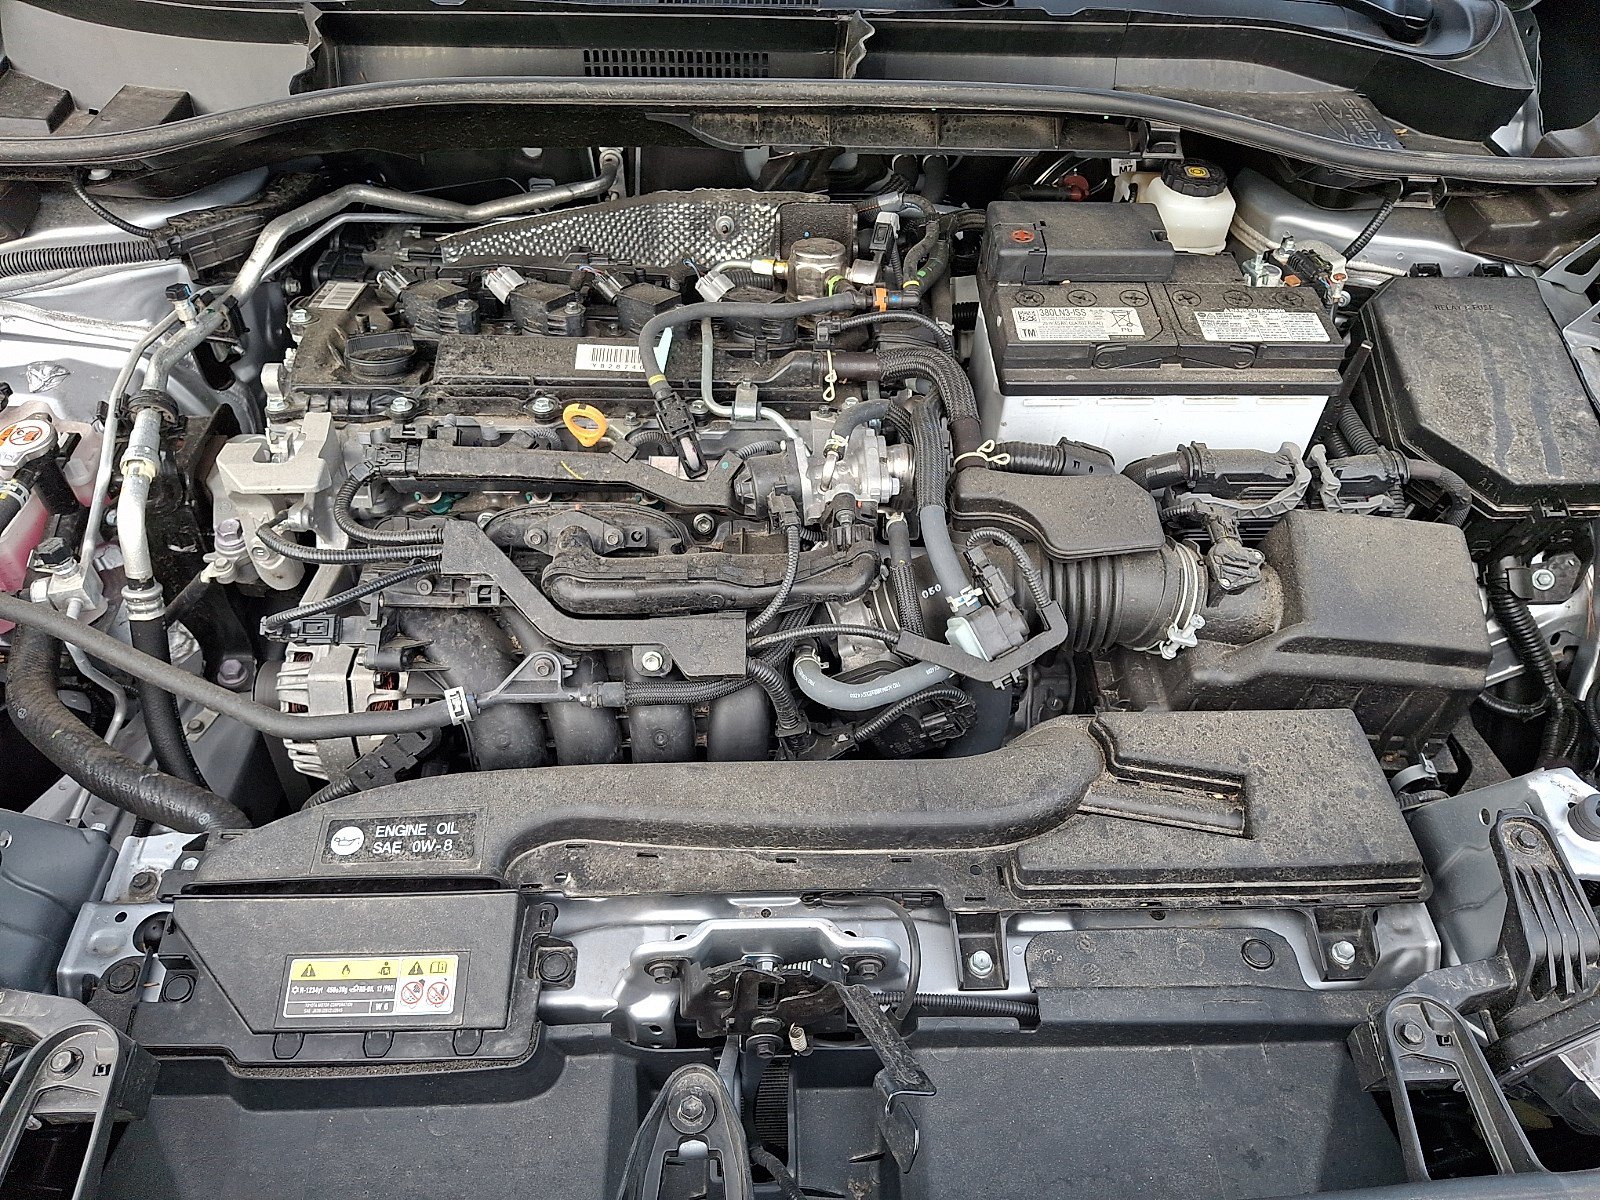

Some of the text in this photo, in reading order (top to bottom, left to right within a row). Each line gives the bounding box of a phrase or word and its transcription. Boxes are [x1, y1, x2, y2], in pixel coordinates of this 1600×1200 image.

[1039, 308, 1087, 317] 380LN3-ISS
[1022, 328, 1036, 338] TM
[375, 822, 459, 838] ENGINE OIL
[373, 839, 453, 854] SAE 0W-8
